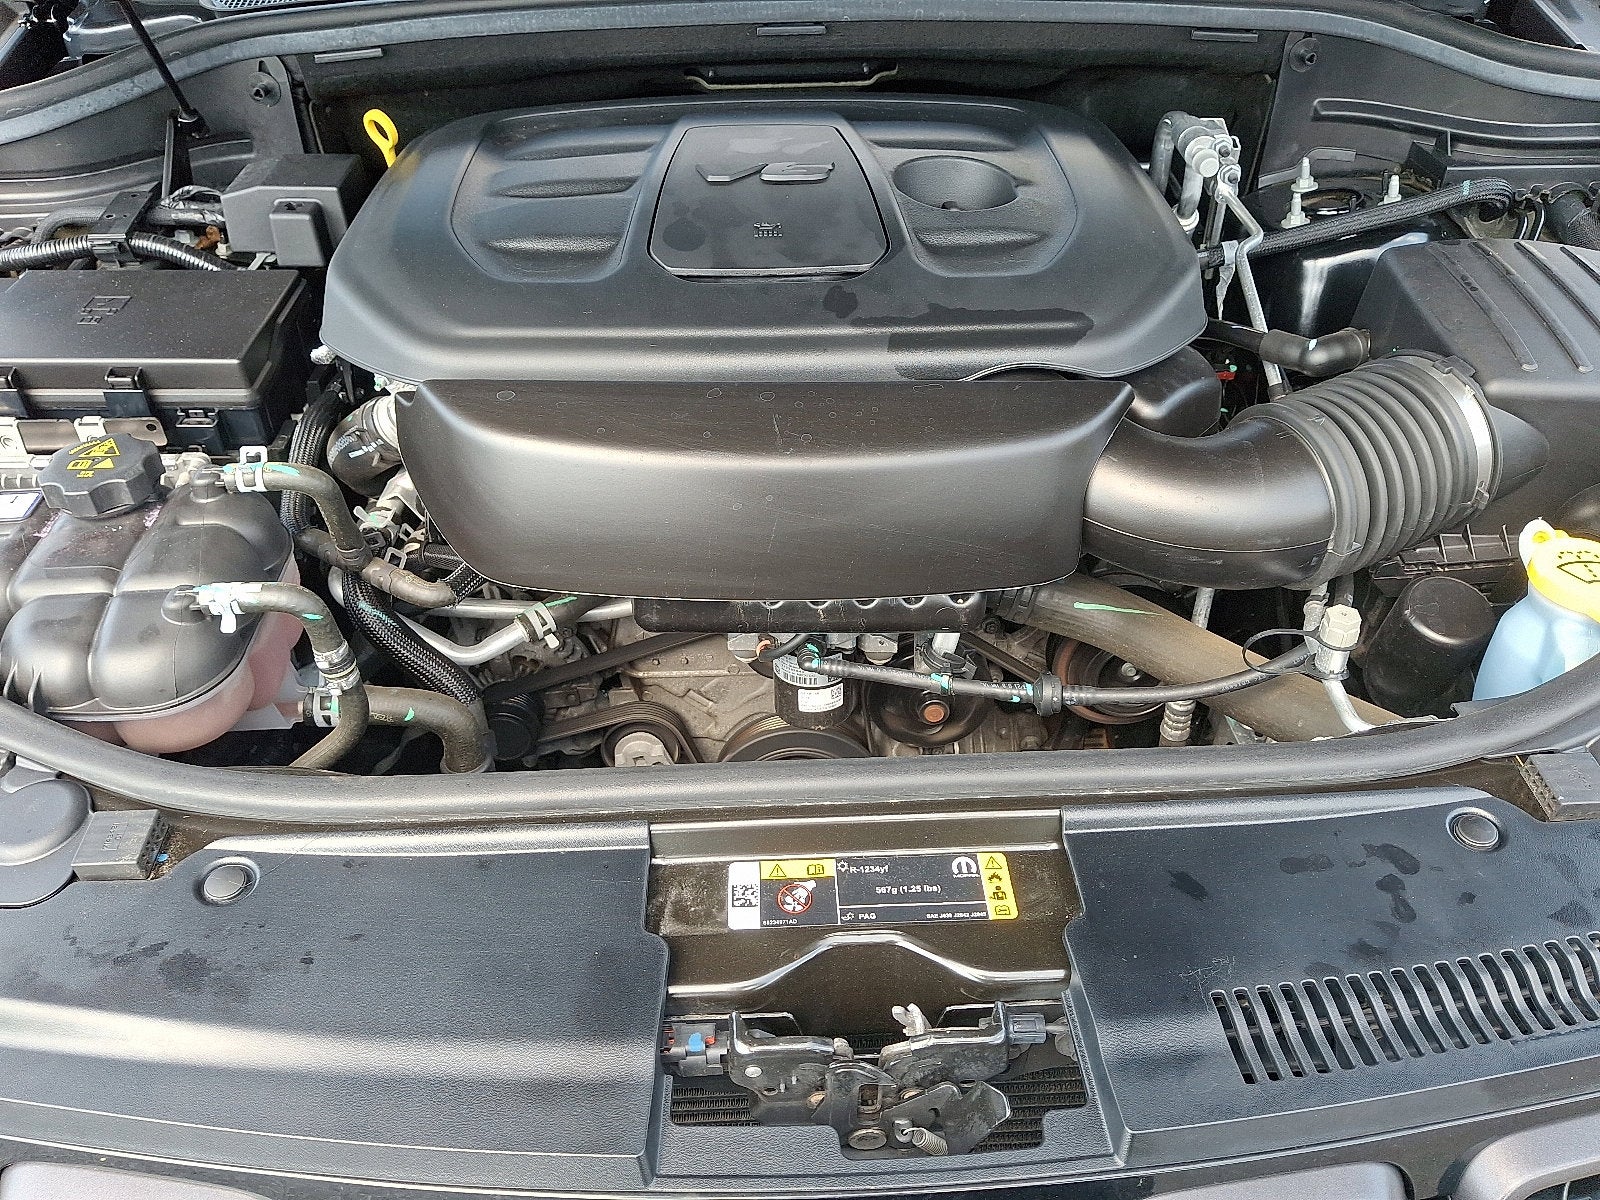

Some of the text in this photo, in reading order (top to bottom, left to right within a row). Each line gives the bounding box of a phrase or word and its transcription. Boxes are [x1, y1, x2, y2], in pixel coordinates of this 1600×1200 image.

[850, 864, 889, 875] R-1234yf
[875, 884, 942, 895] 567g (1.25 lbs)
[858, 912, 876, 920] PAG
